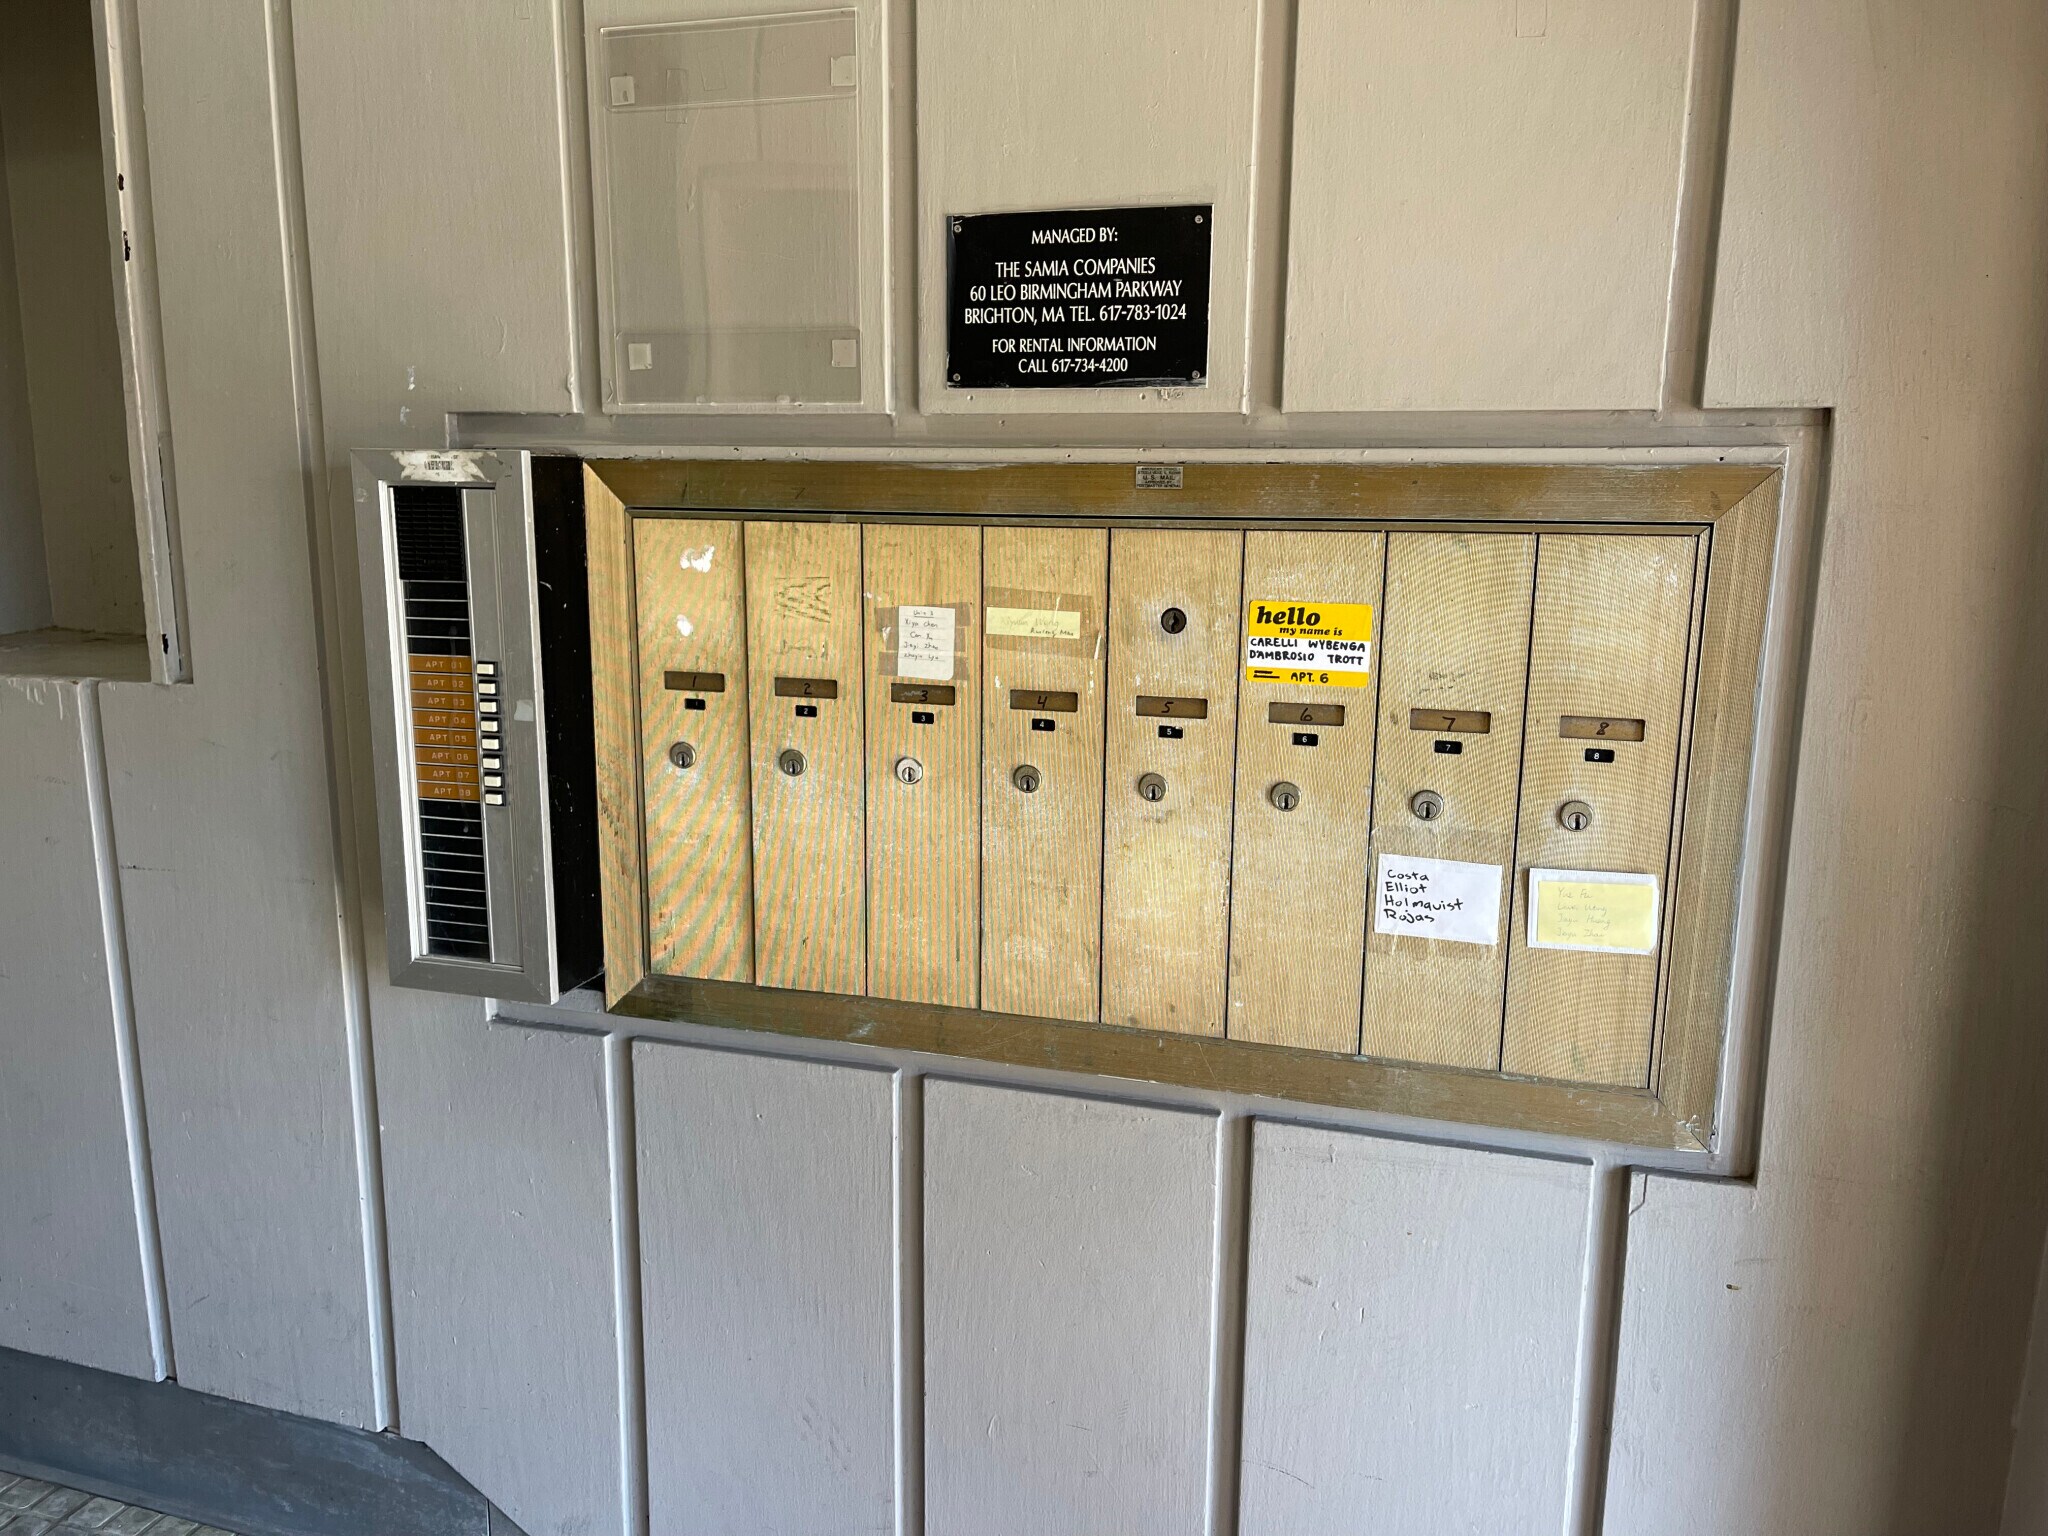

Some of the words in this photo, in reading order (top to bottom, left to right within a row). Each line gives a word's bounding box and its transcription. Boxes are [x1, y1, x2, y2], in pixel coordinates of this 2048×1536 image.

[1032, 228, 1096, 244] MANAGED
[1099, 227, 1118, 242] BY:
[995, 262, 1020, 278] THE
[1025, 260, 1069, 276] SAMIA
[1073, 257, 1156, 276] COMPANIES
[970, 286, 986, 302] 60
[990, 284, 1016, 301] LEO
[1020, 282, 1112, 300] BIRMINGHAM
[1116, 280, 1182, 297] PARKWAY
[964, 307, 1038, 326] BRIGHTON,
[1042, 307, 1065, 322] MA
[1070, 306, 1095, 322] TEL.
[1099, 304, 1187, 321] 617-783-1024
[992, 339, 1016, 353] FOR
[1020, 338, 1064, 352] RENTAL
[1068, 336, 1156, 352] INFORMATION
[1018, 359, 1048, 373] CALL
[1052, 358, 1128, 372] 617-734-4200
[1256, 606, 1320, 626] hello
[1280, 627, 1296, 636] my
[1334, 627, 1342, 636] is
[1251, 638, 1297, 648] CARELLI
[1308, 640, 1366, 652] WYBENGA
[1250, 650, 1314, 662] D'AMBROSIO
[1327, 654, 1364, 666] TROTT
[692, 676, 697, 688] 1
[1291, 672, 1315, 682] APT.
[1320, 673, 1329, 683] 6
[804, 683, 812, 695] 2
[918, 690, 928, 702] 3
[1037, 696, 1047, 708] 4
[1161, 702, 1173, 713] 5
[1300, 707, 1313, 722] 6
[1442, 716, 1456, 732] 7
[1596, 722, 1609, 735] 8
[1387, 869, 1429, 881] Costa
[1385, 881, 1427, 894] Elliot
[1385, 894, 1464, 911] Holmquist
[1384, 909, 1434, 924] Rojas
